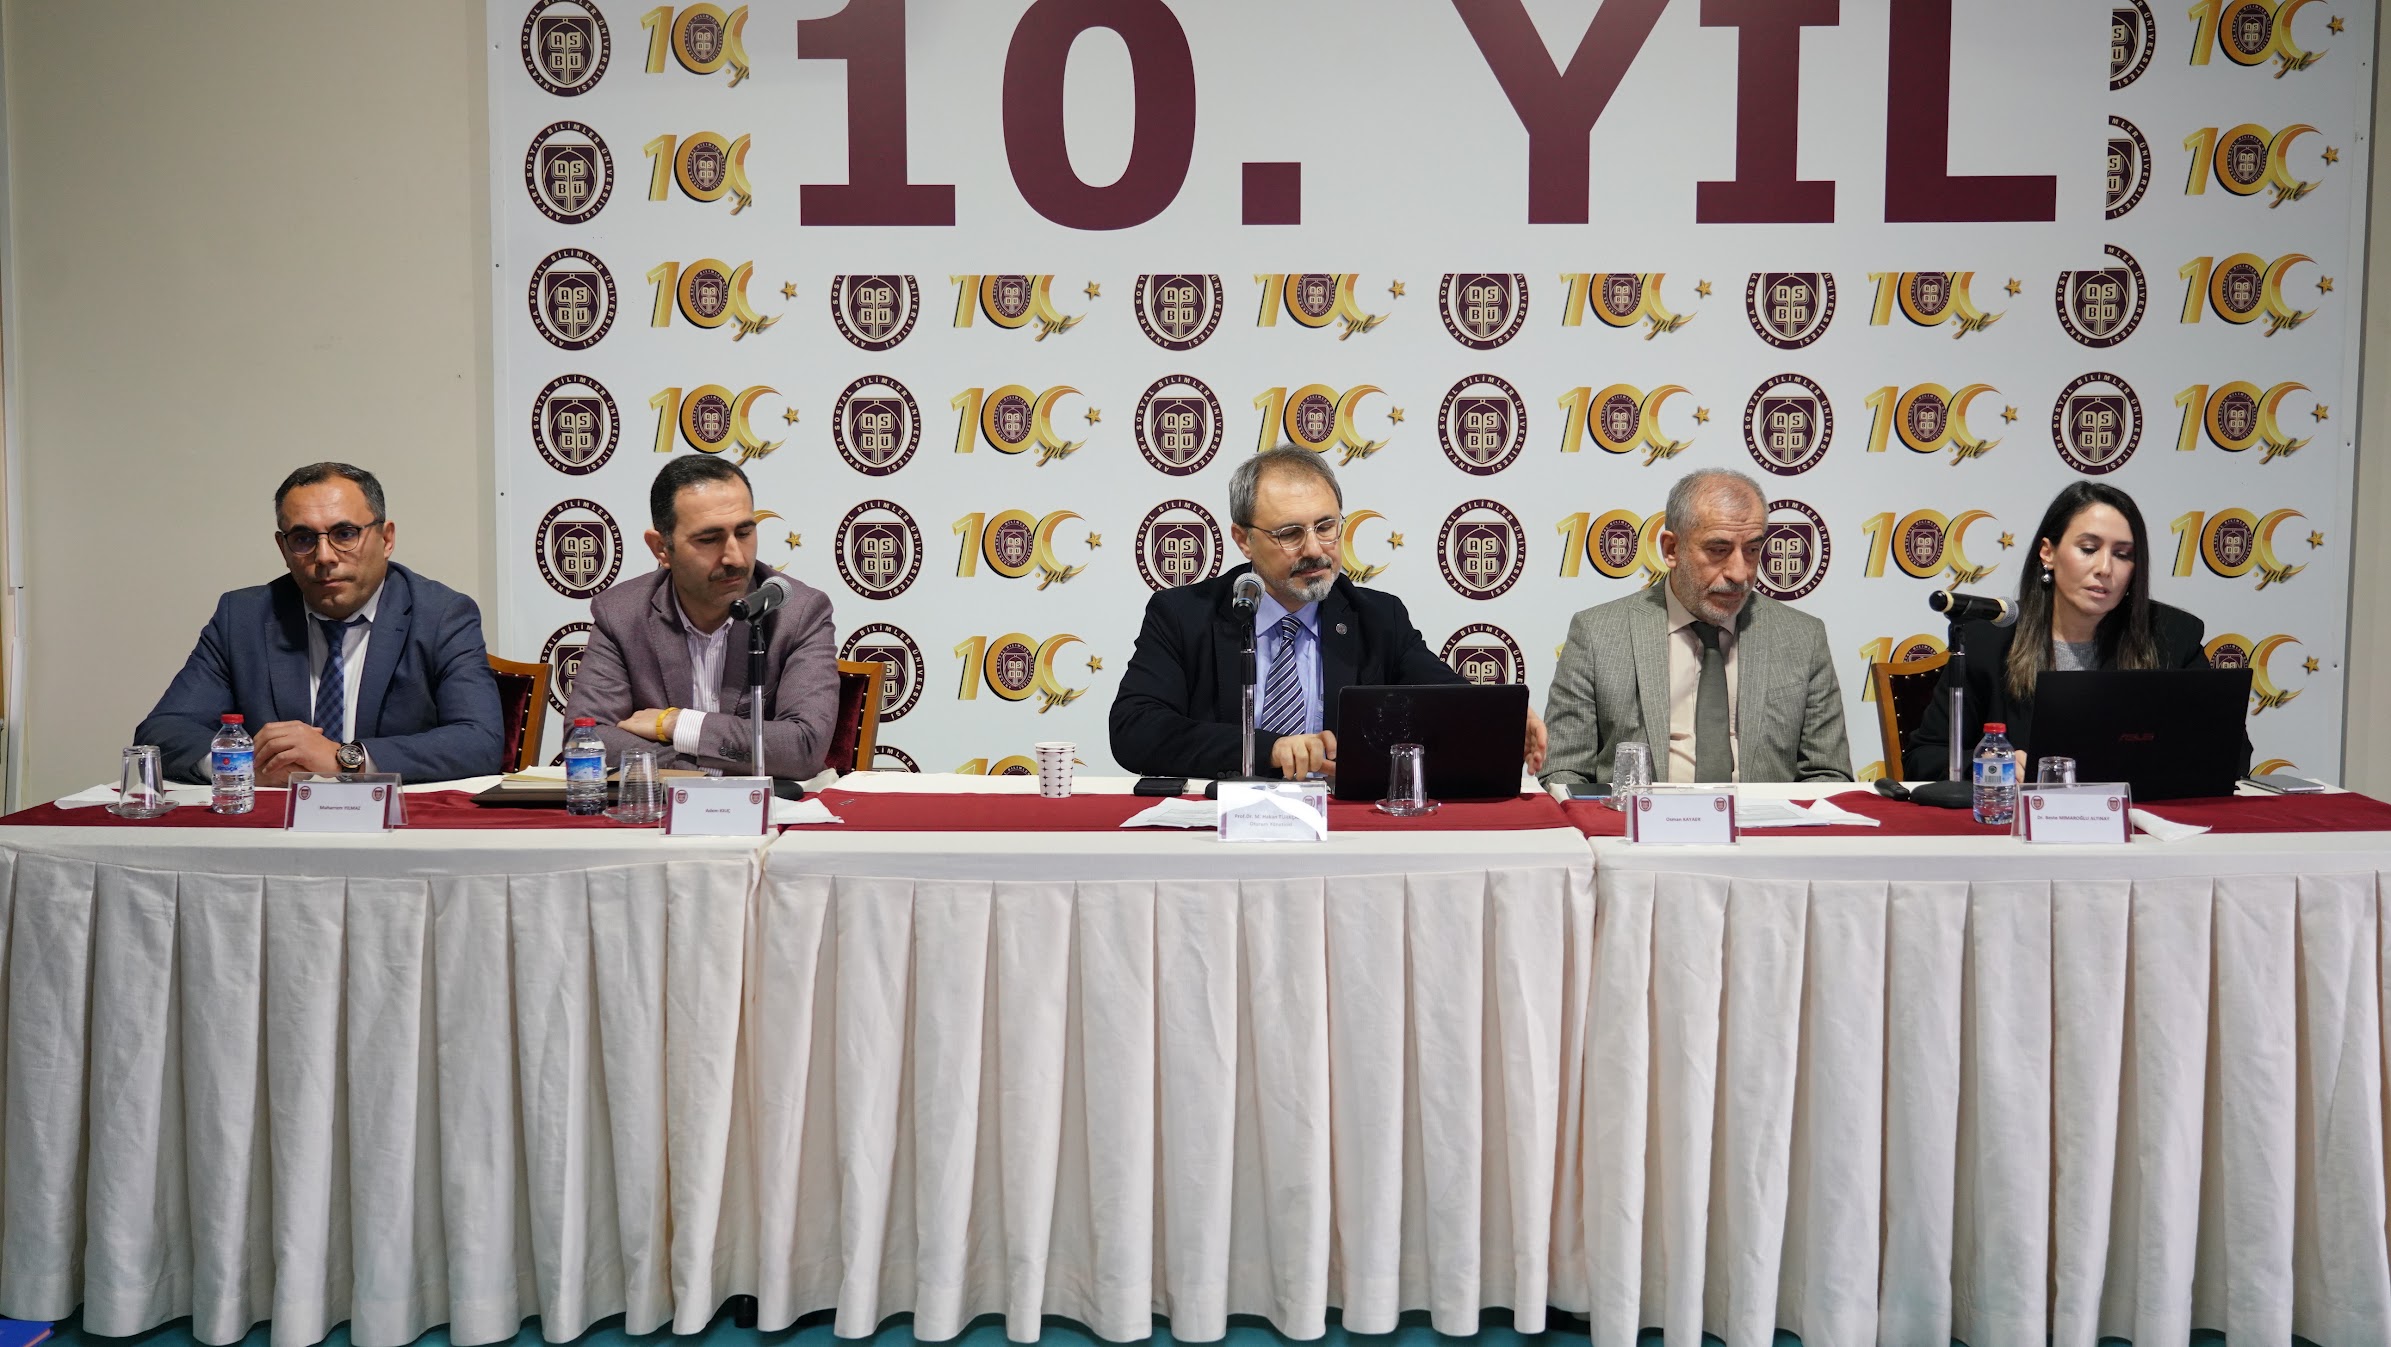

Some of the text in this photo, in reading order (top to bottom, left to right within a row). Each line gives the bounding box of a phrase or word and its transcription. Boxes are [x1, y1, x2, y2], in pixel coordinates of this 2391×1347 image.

[523, 8, 540, 49] SOSYAL
[796, 0, 2057, 231] 10. YIL
[526, 137, 544, 178] SOSYAL
[530, 264, 548, 304] SOSYAL
[533, 390, 551, 430] SOSYAL
[834, 390, 852, 430] SOSYAL
[1136, 390, 1154, 430] SOSYAL
[1440, 389, 1458, 430] SOSYAL
[1745, 389, 1764, 430] SOSYAL
[2053, 388, 2073, 428] SOSYAL
[537, 514, 554, 554] SOSYAL
[837, 515, 854, 555] SOSYAL
[1137, 515, 1155, 555] SOSYAL
[1439, 514, 1457, 554] SOSYAL
